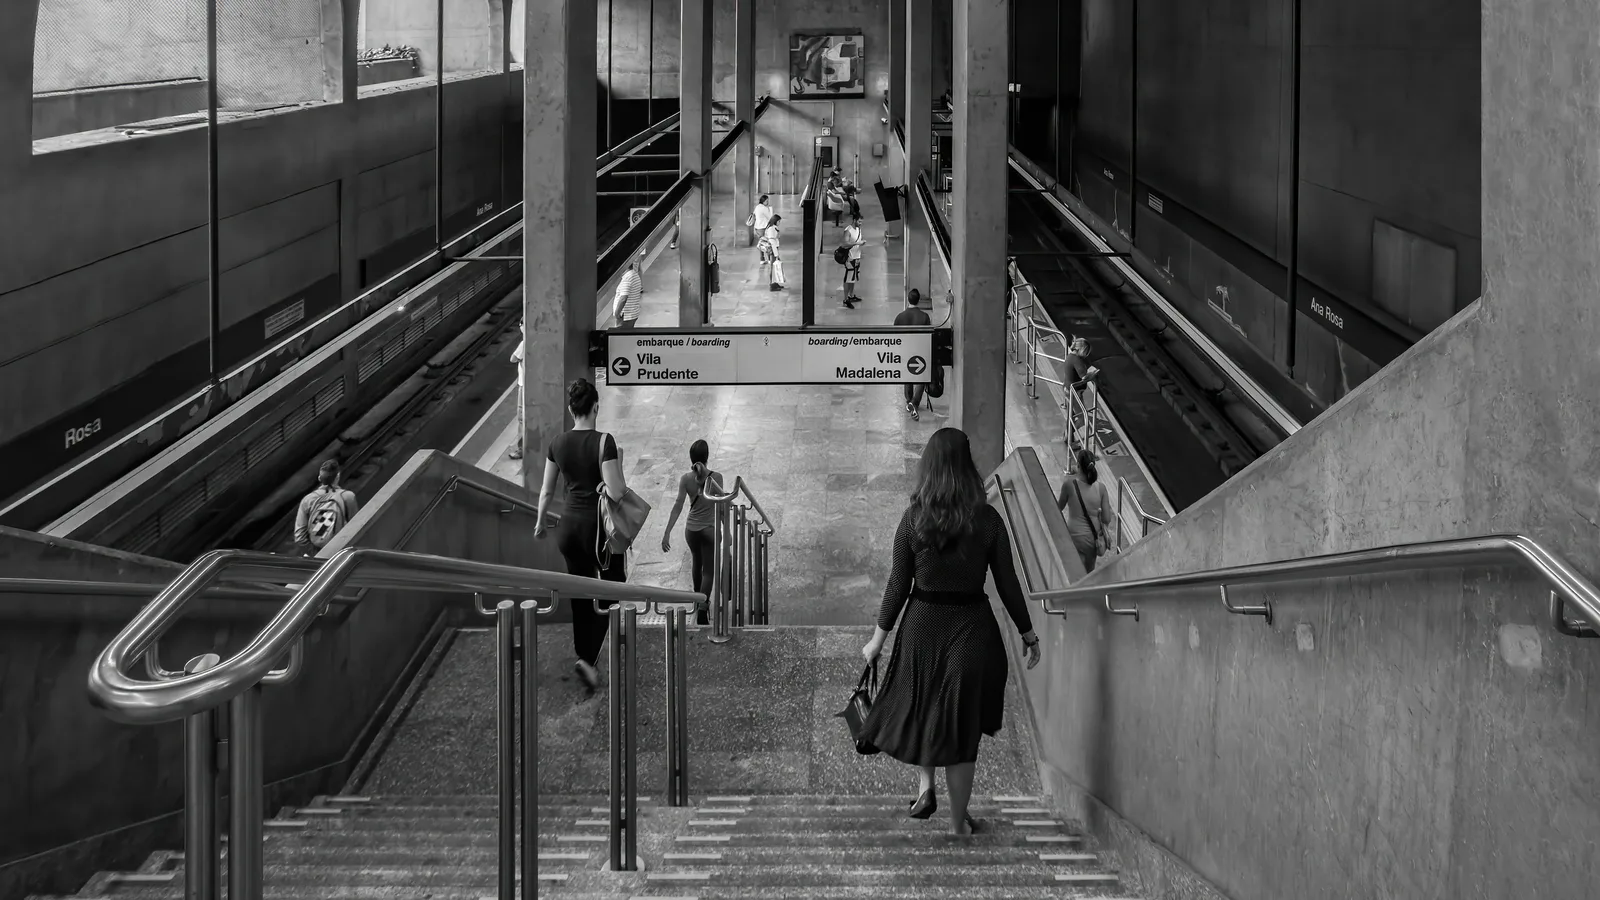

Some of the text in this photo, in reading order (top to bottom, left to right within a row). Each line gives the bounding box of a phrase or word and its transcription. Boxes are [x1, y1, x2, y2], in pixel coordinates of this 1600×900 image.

[1310, 296, 1344, 330] Ana Rosa
[636, 337, 684, 348] embarque
[691, 337, 731, 348] boarding
[636, 353, 661, 365] Vila
[877, 352, 902, 364] Vila
[637, 368, 699, 380] Prudente
[836, 367, 901, 379] Madalena
[64, 417, 102, 449] Rosa
